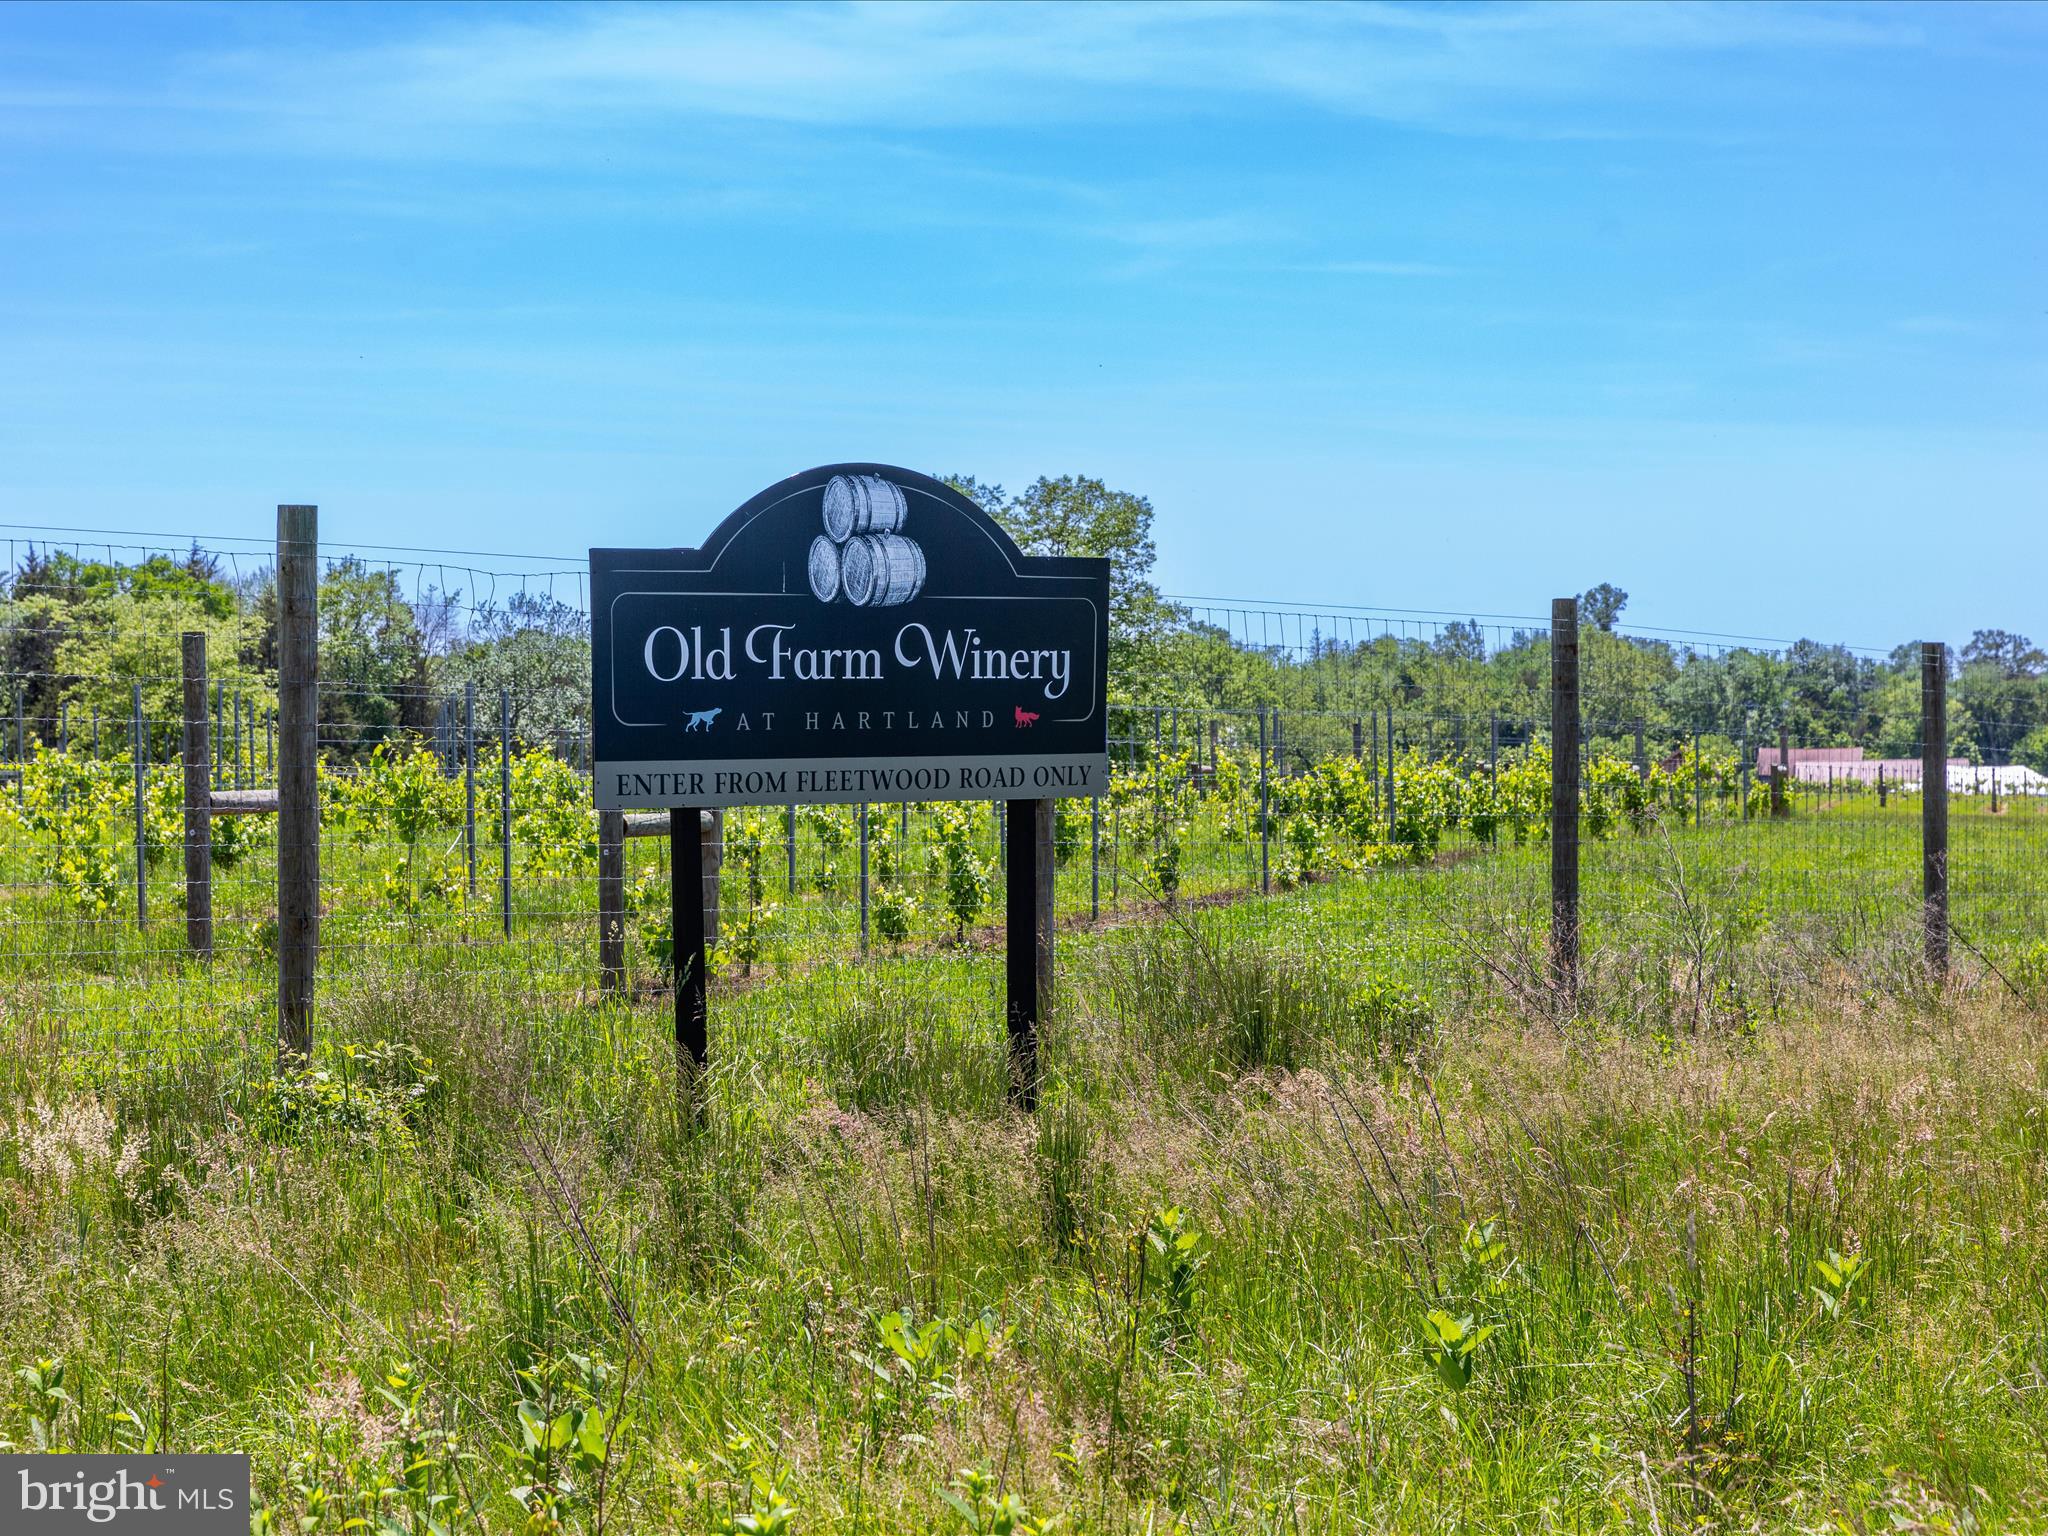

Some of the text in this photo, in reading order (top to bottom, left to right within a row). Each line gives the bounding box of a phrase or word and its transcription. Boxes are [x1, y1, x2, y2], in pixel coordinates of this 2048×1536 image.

[644, 622, 1071, 699] Old Farm Winery
[736, 711, 996, 731] AT HARTLAND
[616, 765, 1092, 796] ENTER FROM FLEETWOOD ROAD ONLY
